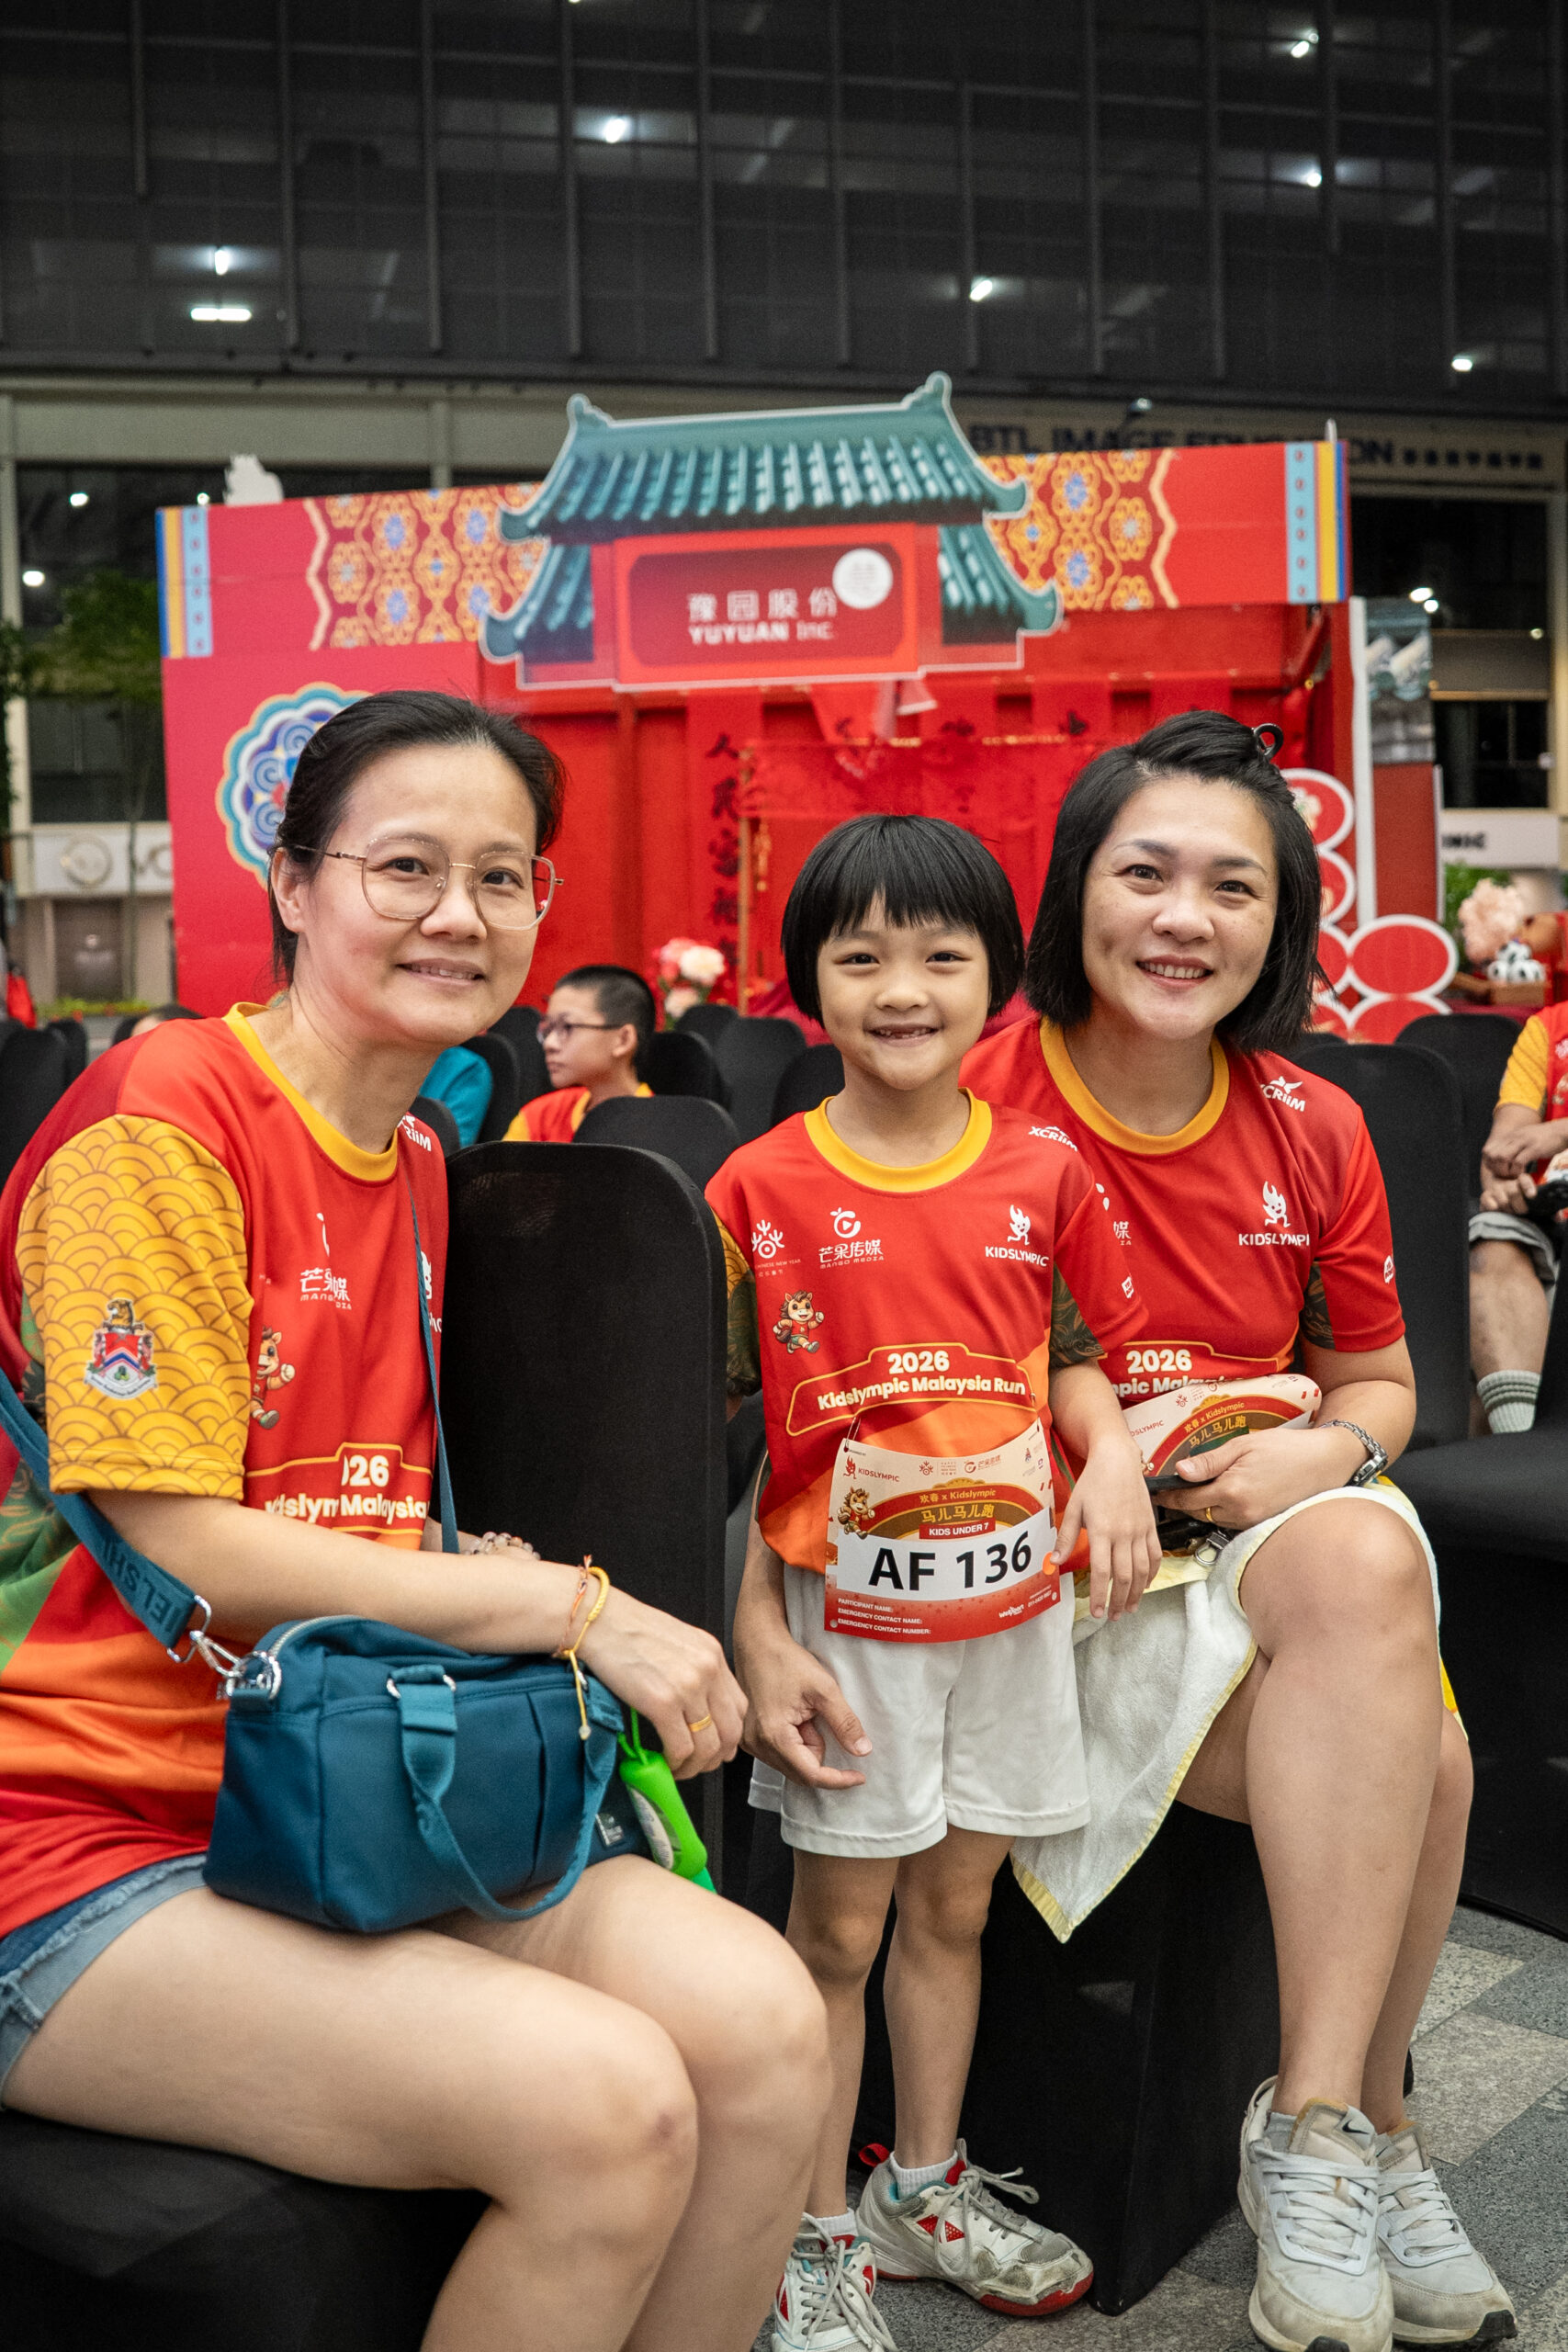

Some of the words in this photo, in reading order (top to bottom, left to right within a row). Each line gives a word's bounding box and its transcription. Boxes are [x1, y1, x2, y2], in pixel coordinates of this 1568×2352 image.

[689, 621, 790, 645] YUYUAN
[1238, 1233, 1310, 1246] KIDSLYMPI
[818, 1238, 884, 1264] 芒果传媒
[985, 1245, 1050, 1267] KIDSLYMPIC
[887, 1351, 951, 1374] 2026
[1126, 1349, 1193, 1374] 2026
[817, 1377, 910, 1411] Kidslympic
[911, 1374, 992, 1396] Malaysia
[993, 1377, 1027, 1396] Run
[1205, 1401, 1245, 1420] Kidslympic
[1189, 1415, 1247, 1448] 马儿马儿跑
[858, 1467, 899, 1482] KIDSLYMPIC
[950, 1488, 997, 1499] Kidslympic
[920, 1503, 995, 1523] 马儿马儿跑
[929, 1527, 952, 1536] KIDS
[953, 1524, 983, 1535] UNDER
[984, 1521, 989, 1530] 7
[868, 1547, 936, 1591] AF
[956, 1531, 1032, 1589] 136
[838, 1598, 874, 1610] PARTICIPANT
[838, 1608, 873, 1619] EMERGENCY
[874, 1614, 901, 1623] CONTACT
[838, 1618, 873, 1630] EMERGENCY
[874, 1624, 901, 1634] CONTACT
